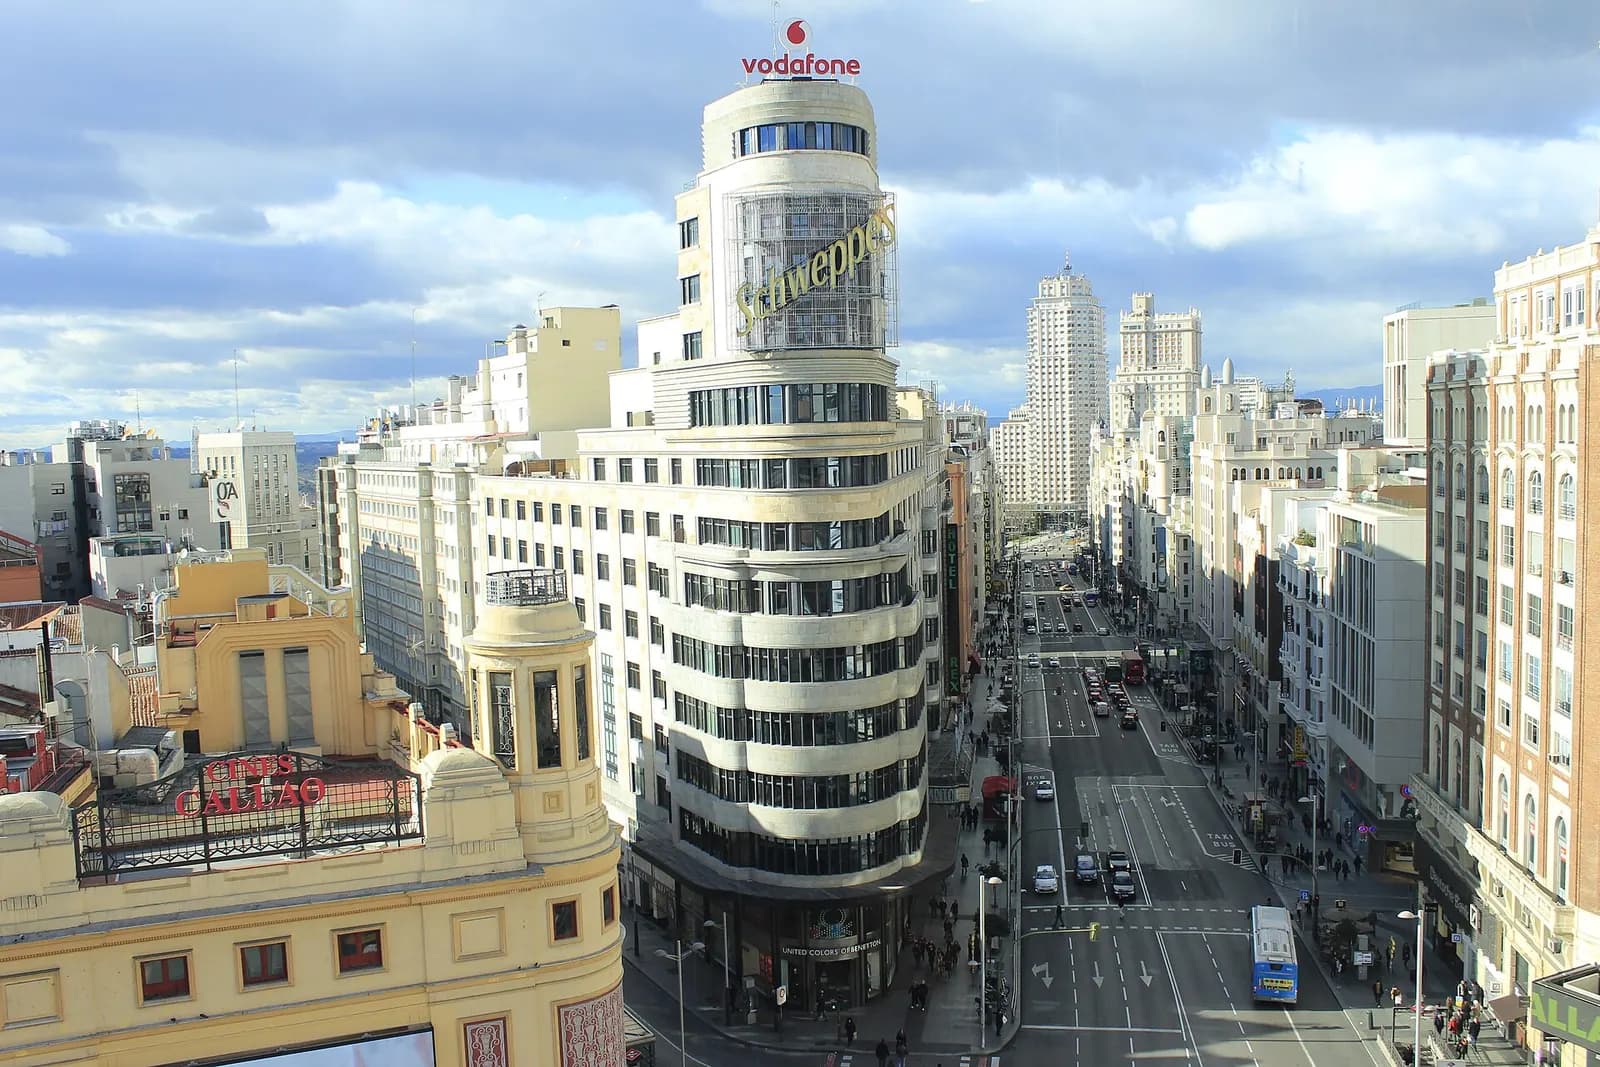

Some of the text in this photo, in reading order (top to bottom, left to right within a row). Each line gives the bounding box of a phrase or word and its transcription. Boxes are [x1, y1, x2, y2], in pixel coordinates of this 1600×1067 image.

[742, 53, 861, 76] vodafone
[737, 203, 895, 338] Schweppes
[947, 528, 960, 692] HOTEL REX
[205, 753, 294, 782] CINES
[175, 777, 326, 817] CALLAO
[782, 947, 808, 956] UNITED
[840, 947, 850, 955] OF
[850, 938, 882, 954] BENETTON
